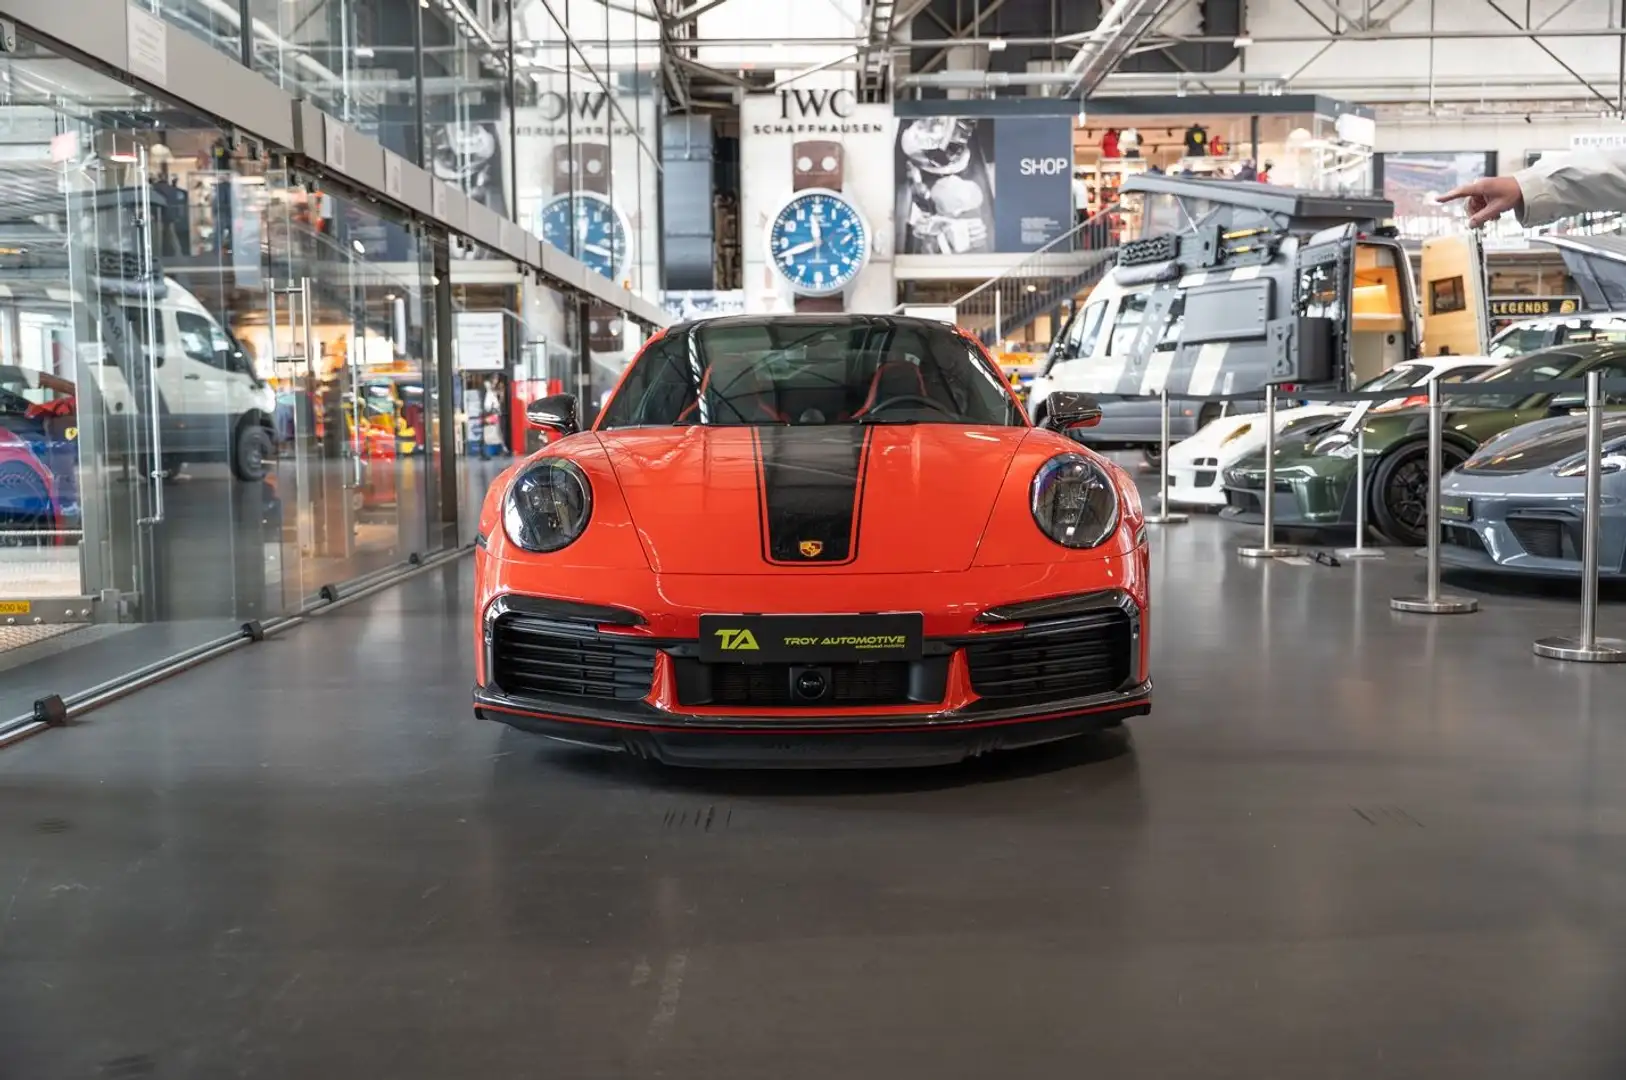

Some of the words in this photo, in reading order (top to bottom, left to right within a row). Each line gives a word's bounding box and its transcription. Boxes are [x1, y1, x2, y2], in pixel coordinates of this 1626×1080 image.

[780, 88, 855, 118] IWC
[753, 124, 883, 134] SCHAFFHAUSEN
[1020, 157, 1068, 175] SHOP
[1492, 301, 1549, 314] LEGENDS
[714, 628, 760, 650] TA
[783, 637, 819, 646] TROY
[820, 635, 906, 645] AUTOMOTIVE
